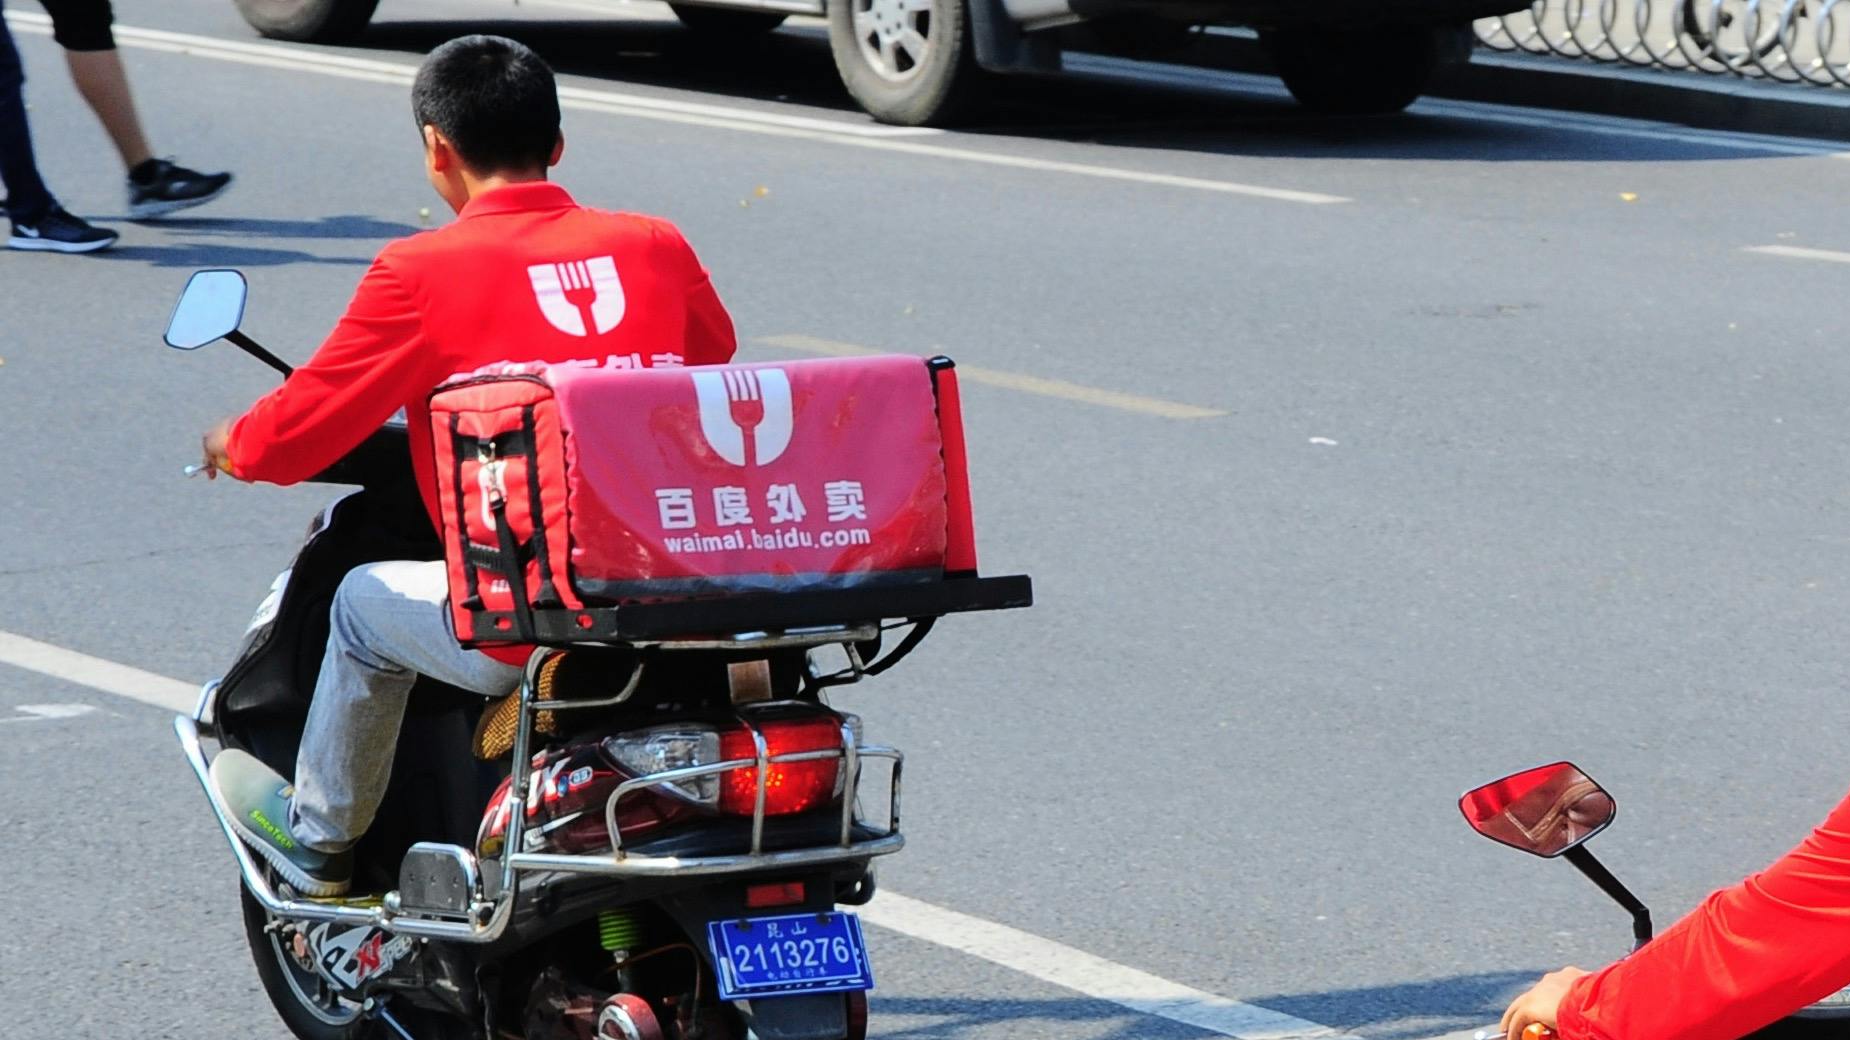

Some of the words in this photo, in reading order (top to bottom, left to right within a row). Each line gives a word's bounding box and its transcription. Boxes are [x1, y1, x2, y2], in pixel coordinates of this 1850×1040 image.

[655, 480, 867, 529] 百度外卖
[664, 528, 870, 553] waimai.baidu.com
[767, 922, 807, 938] 昆山
[735, 937, 849, 972] 2113276
